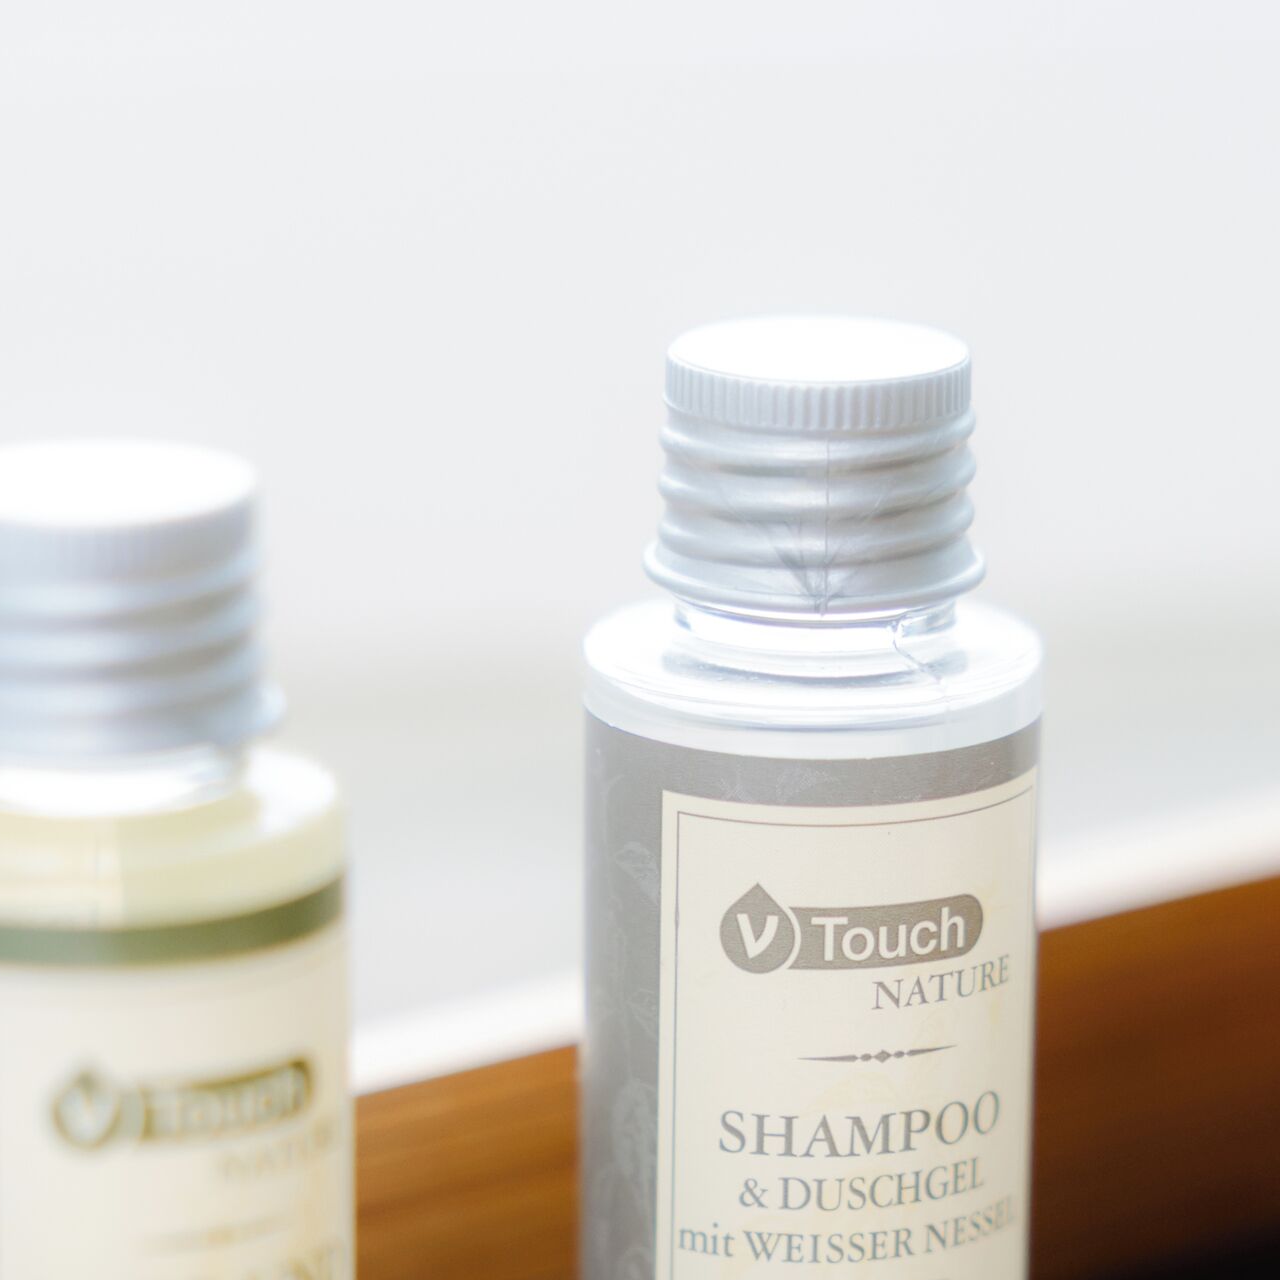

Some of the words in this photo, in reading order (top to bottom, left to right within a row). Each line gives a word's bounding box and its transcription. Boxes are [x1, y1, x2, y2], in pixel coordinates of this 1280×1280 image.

[811, 907, 965, 962] Touch
[871, 954, 1010, 1010] NATURE
[719, 1090, 1001, 1158] SHAMPOO
[738, 1177, 769, 1209] &
[778, 1156, 984, 1212] DUSCHGEL
[678, 1222, 734, 1258] mit
[744, 1227, 915, 1264] WEISSER
[924, 1195, 1015, 1255] NESSEL
